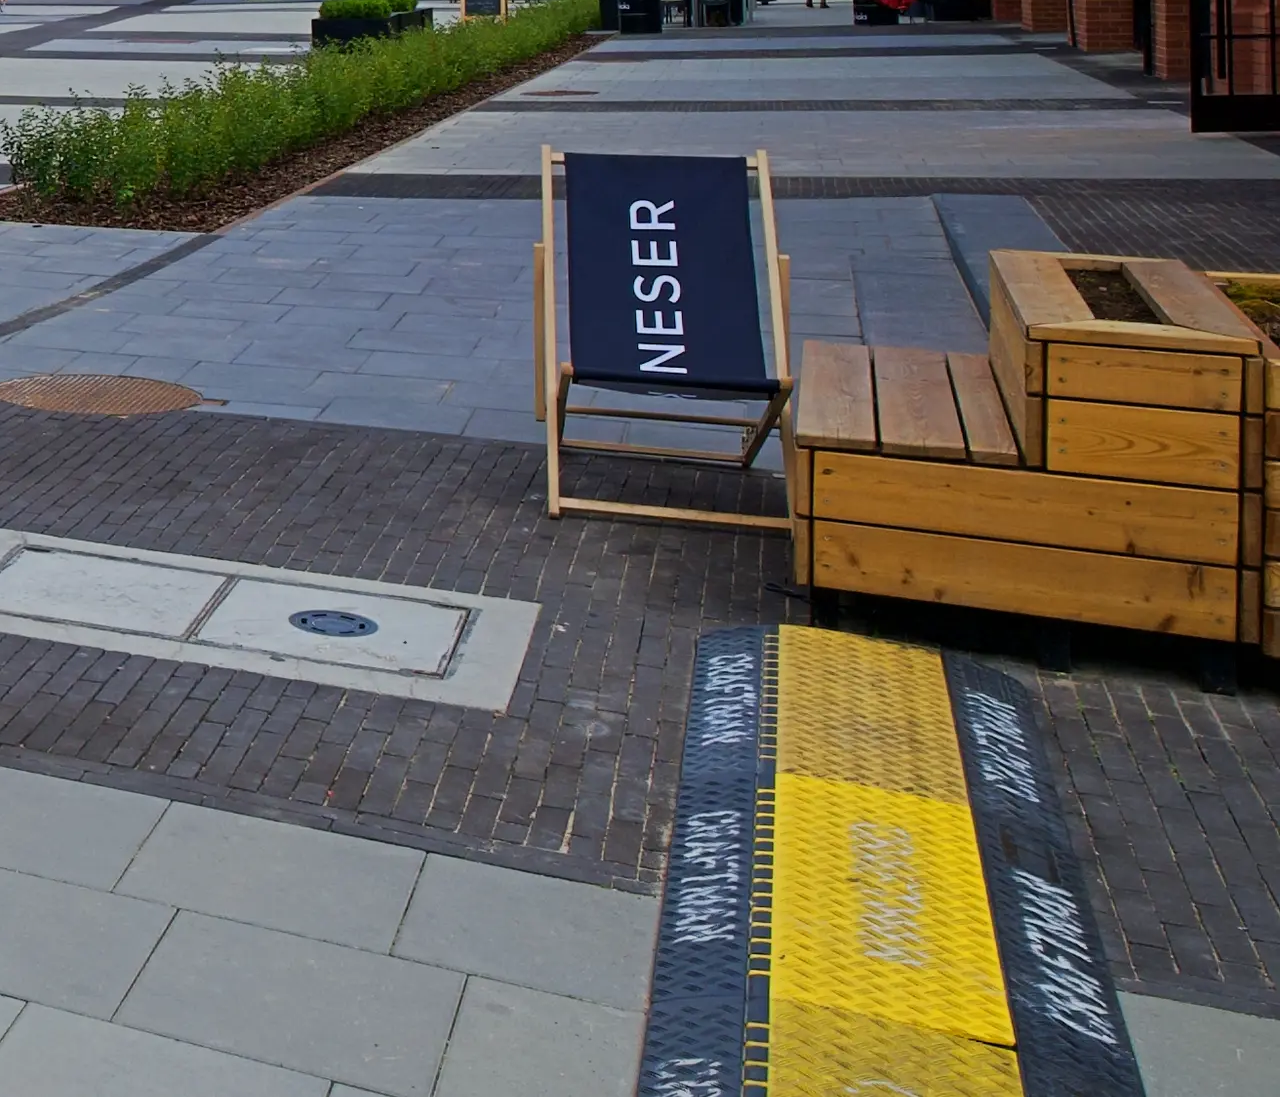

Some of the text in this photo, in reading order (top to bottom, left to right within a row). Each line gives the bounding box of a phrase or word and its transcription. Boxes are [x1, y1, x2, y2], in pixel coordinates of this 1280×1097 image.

[629, 199, 688, 375] NESER
[672, 809, 741, 944] CRAFTMAN
[1010, 866, 1119, 1045] CRAFTMAN
